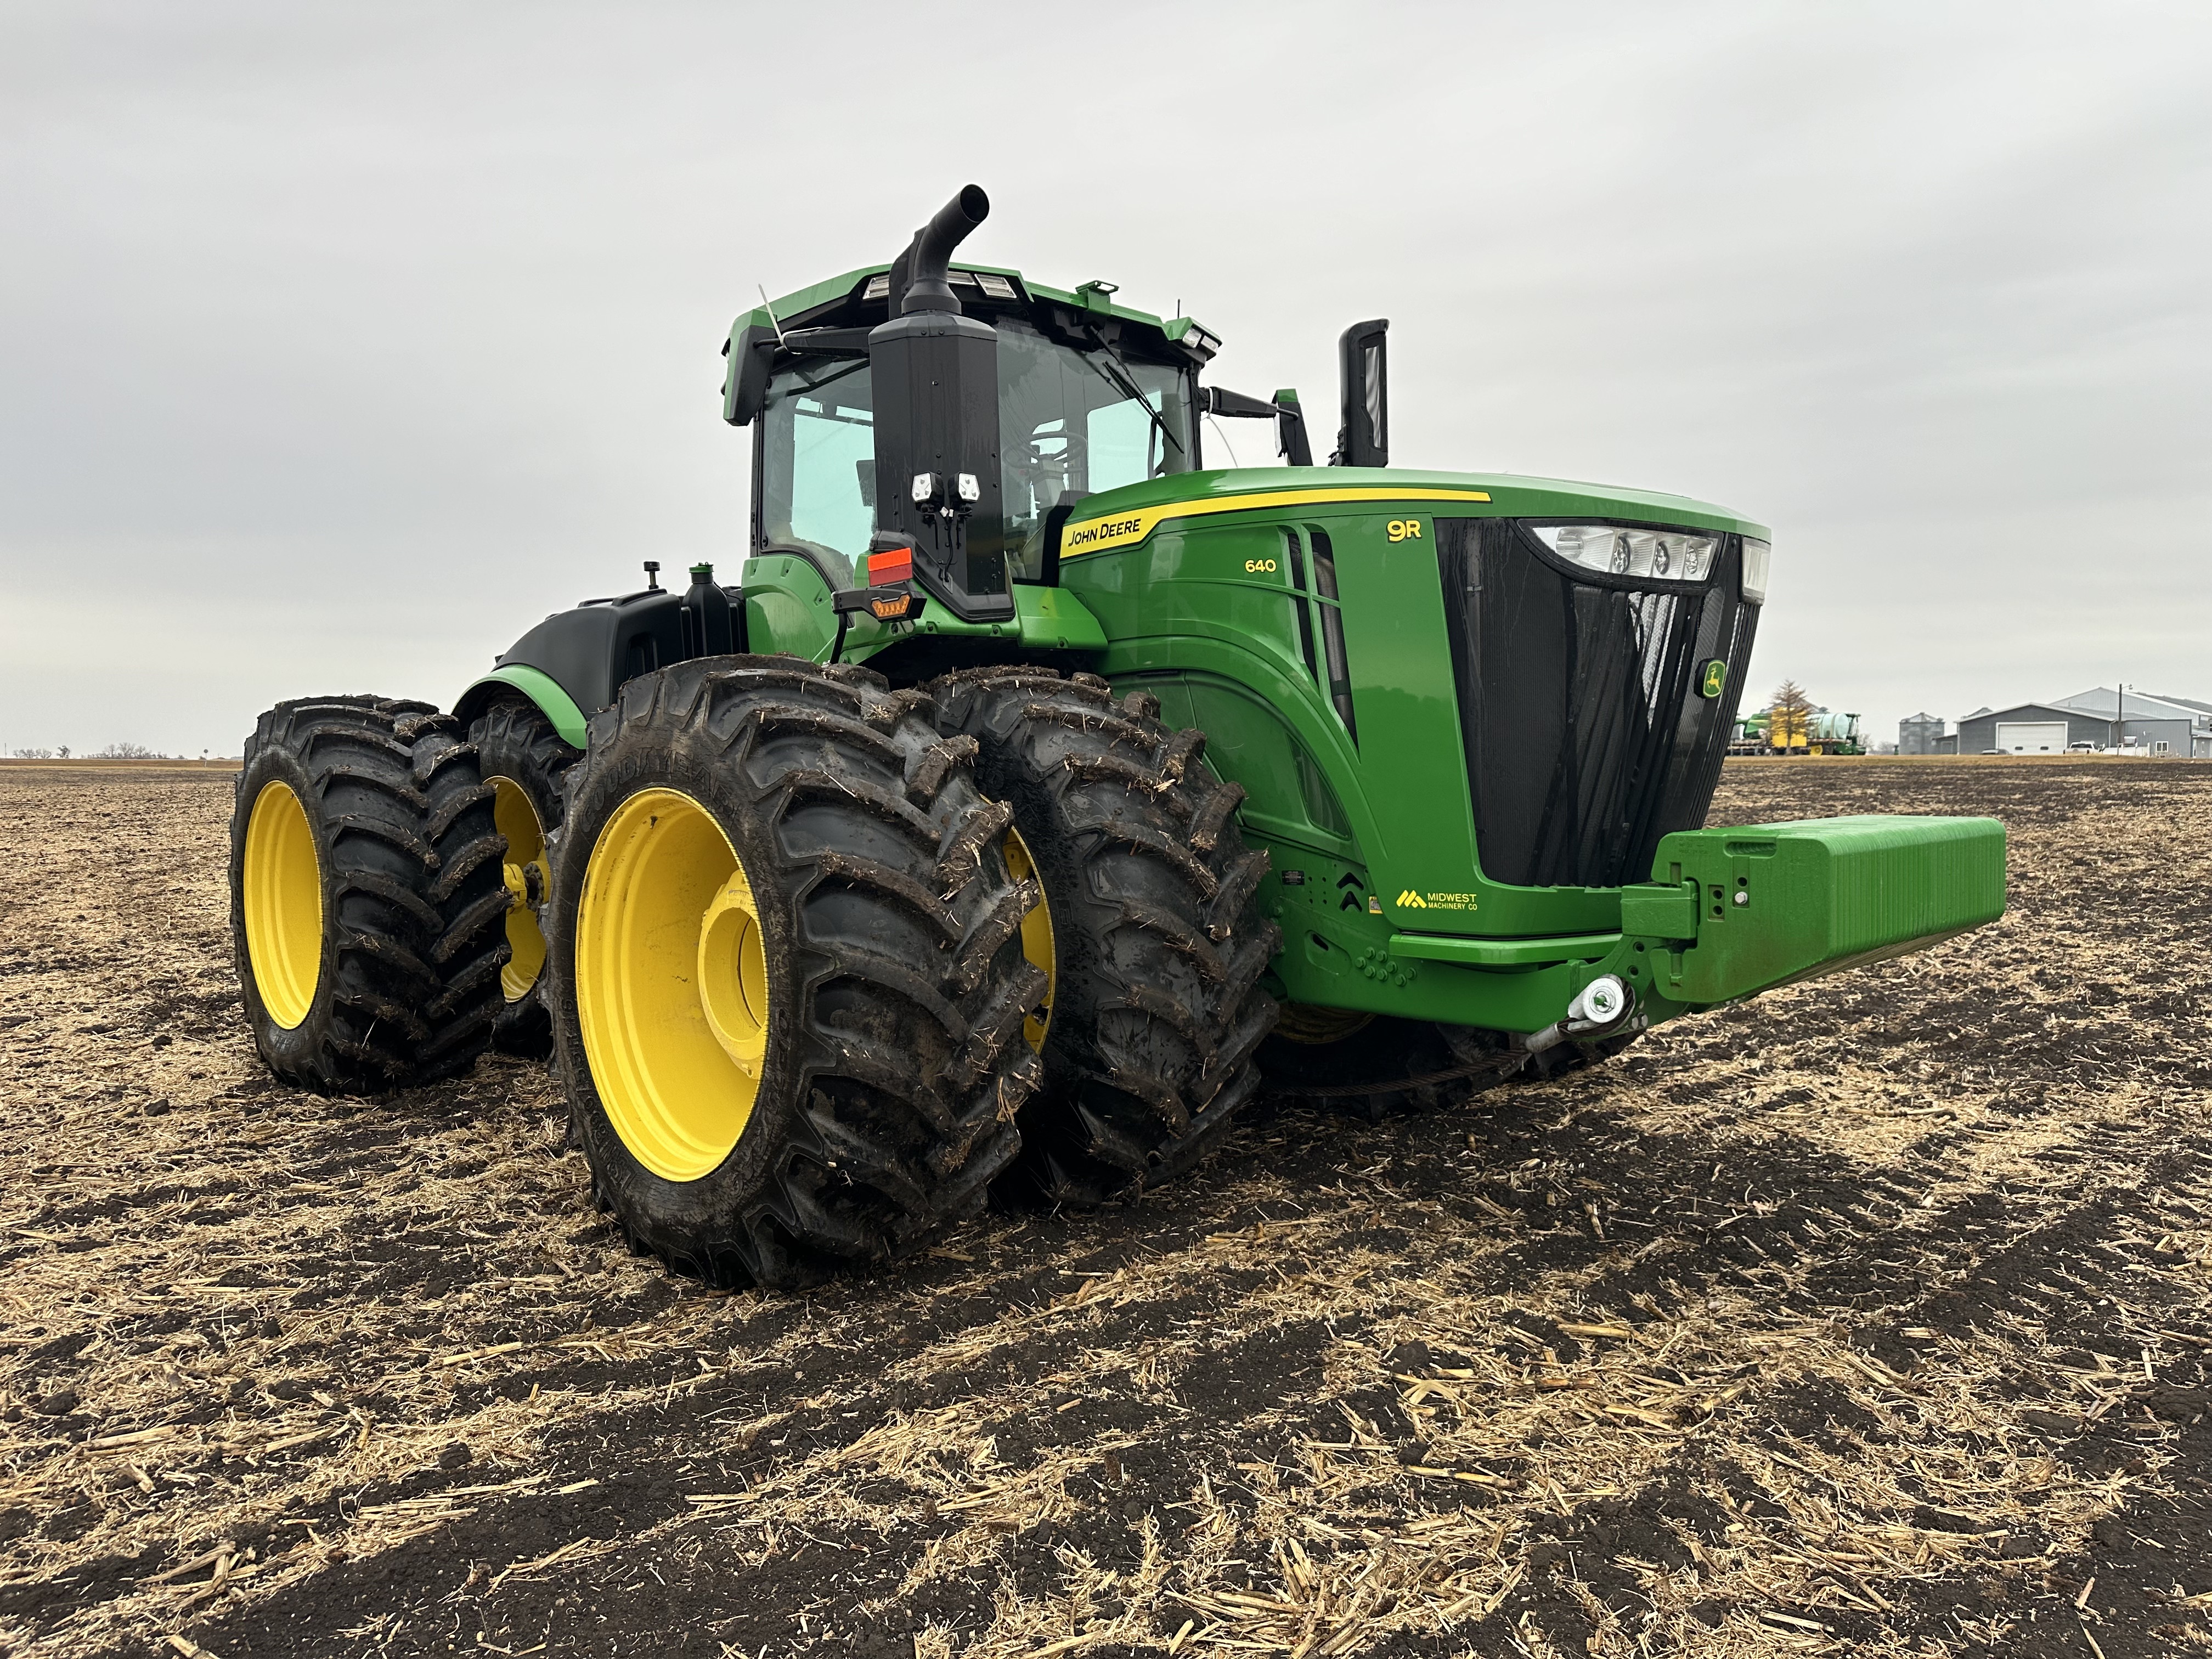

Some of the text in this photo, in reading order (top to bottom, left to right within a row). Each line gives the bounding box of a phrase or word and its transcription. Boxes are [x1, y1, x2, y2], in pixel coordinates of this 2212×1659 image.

[1068, 518, 1141, 546] JOHN DEERE
[1386, 520, 1421, 542] 9R
[1245, 559, 1277, 573] 640
[1427, 893, 1477, 902] MIDWEST
